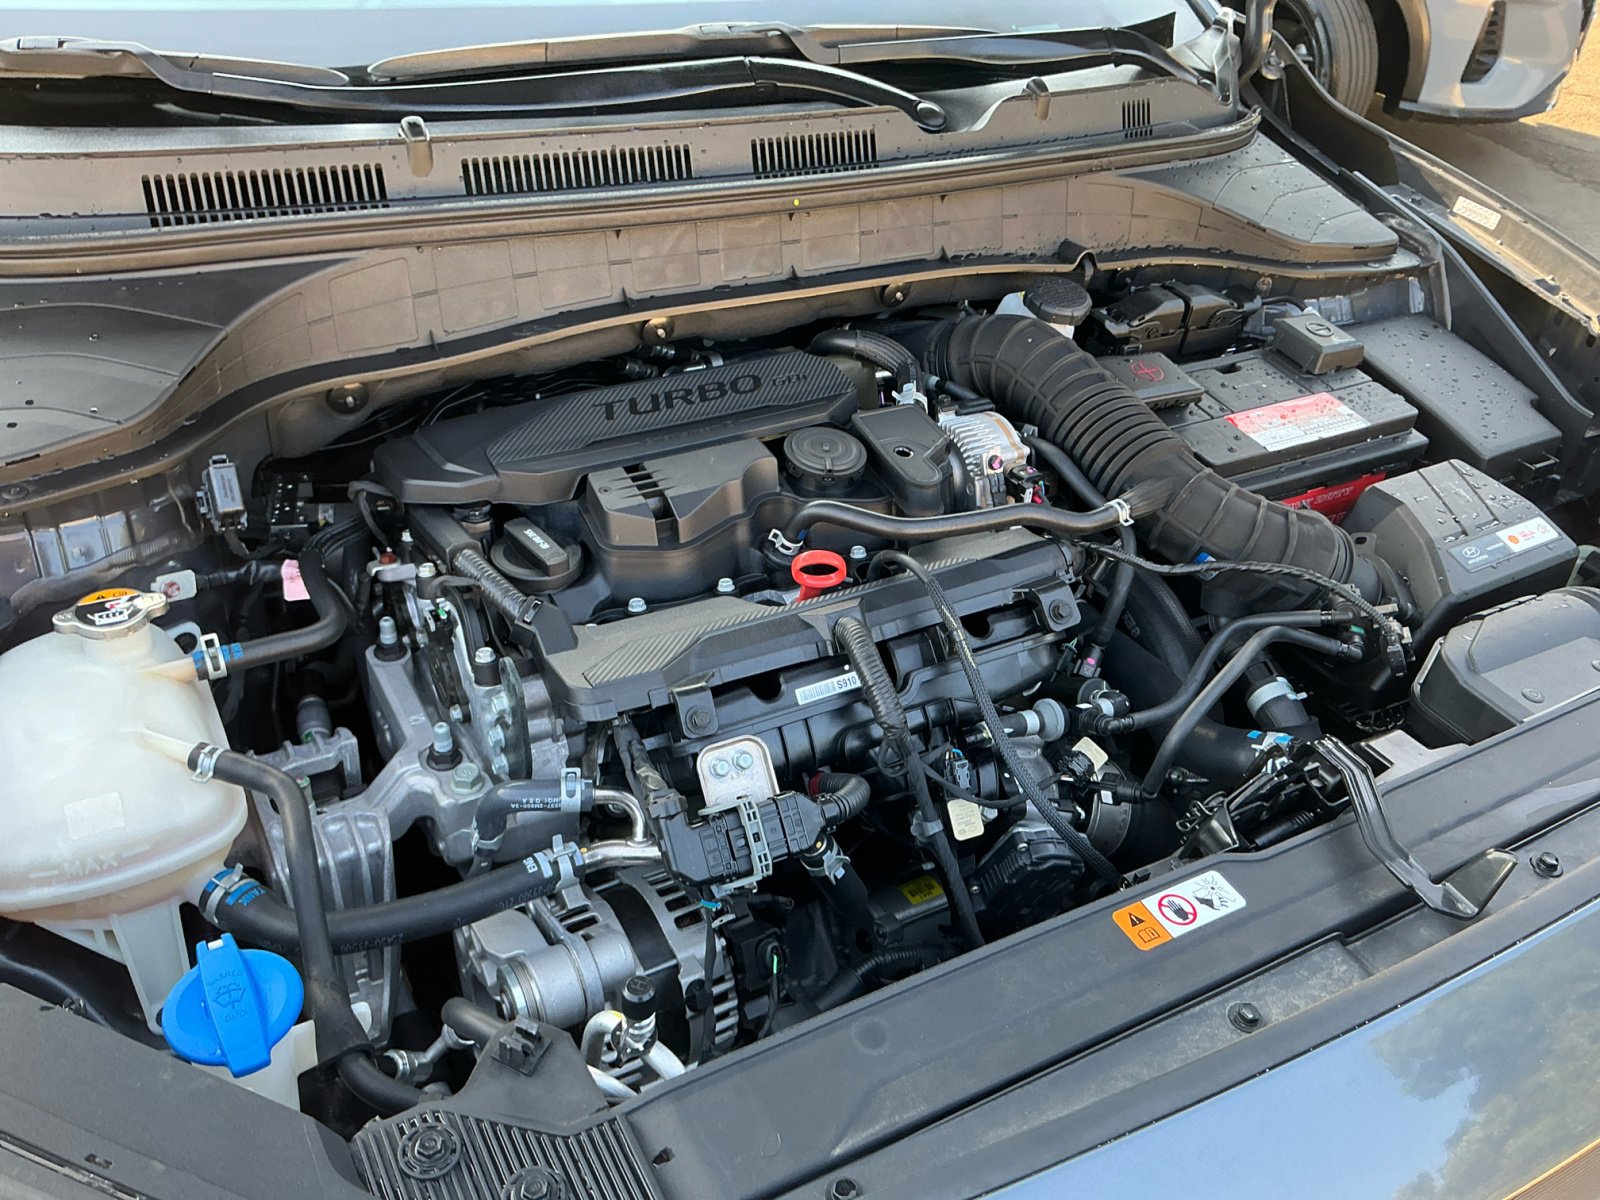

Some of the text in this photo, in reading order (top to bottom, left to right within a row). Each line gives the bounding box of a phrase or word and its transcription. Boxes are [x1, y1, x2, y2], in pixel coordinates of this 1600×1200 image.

[593, 374, 762, 421] TURBO
[836, 675, 857, 689] S910
[63, 852, 118, 878] MAX
[238, 886, 267, 906] TANK
